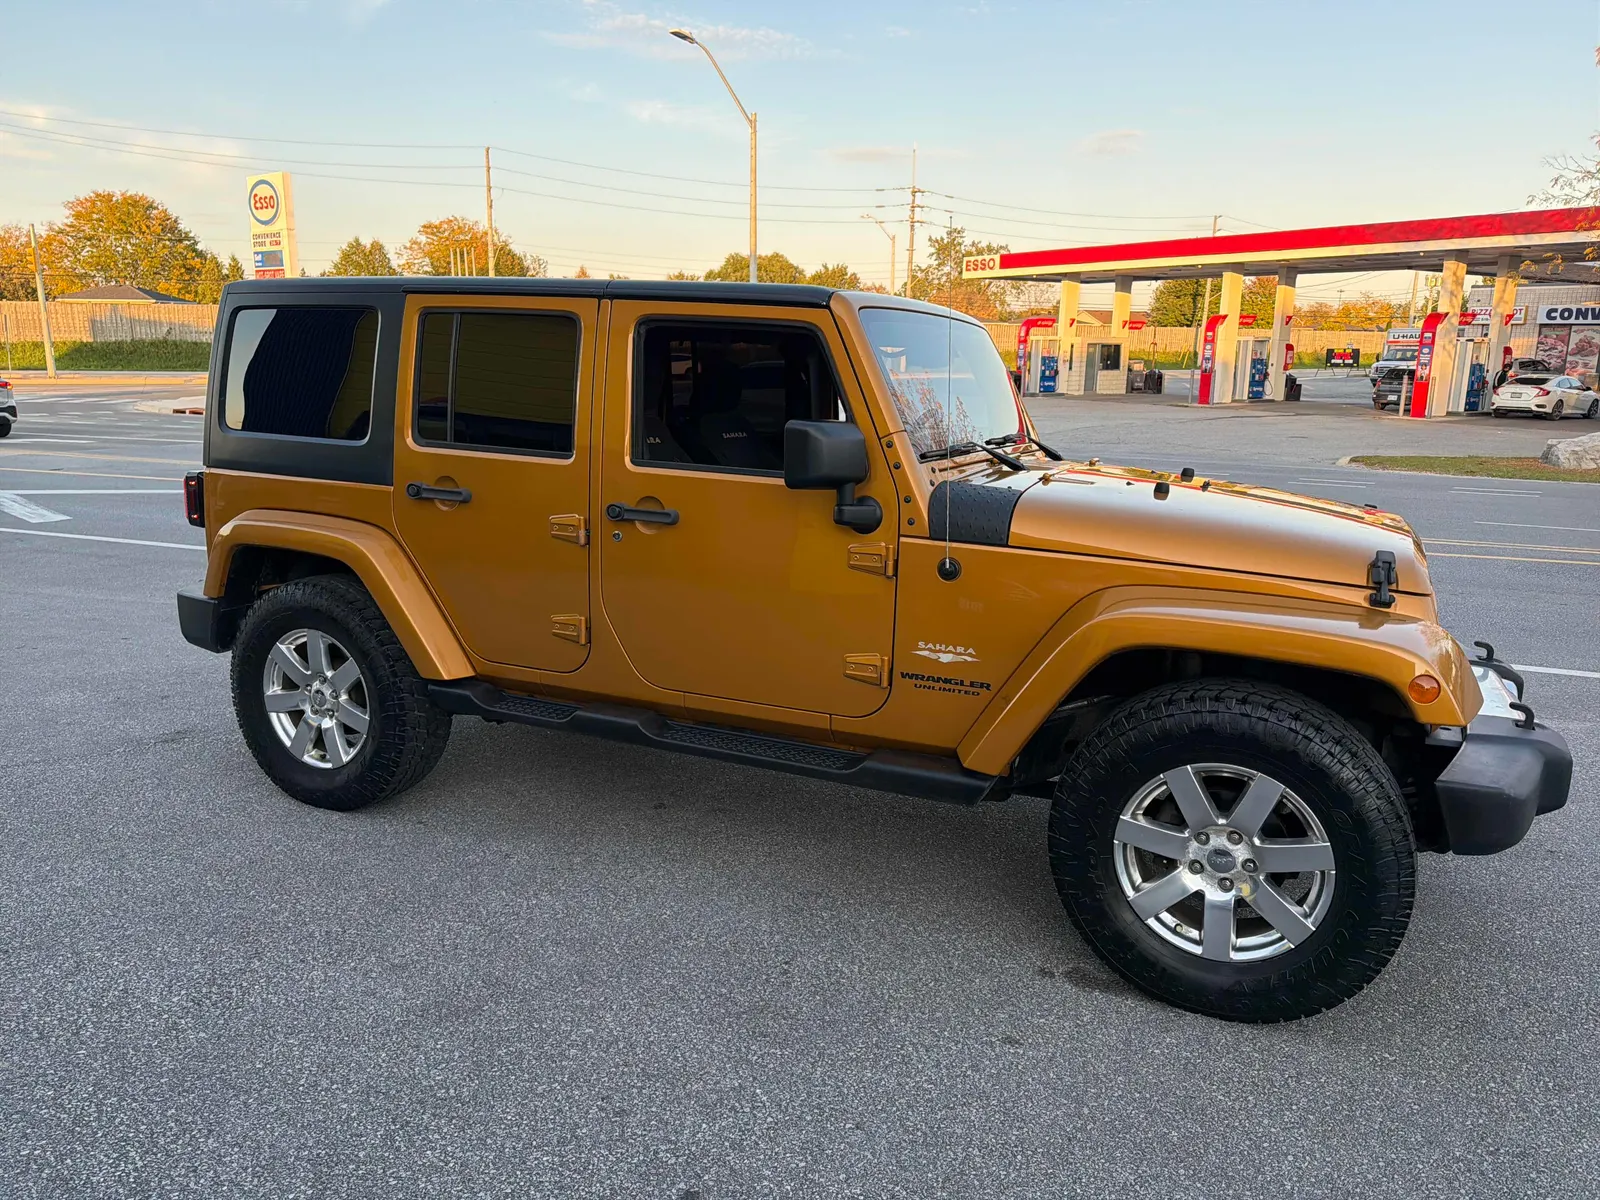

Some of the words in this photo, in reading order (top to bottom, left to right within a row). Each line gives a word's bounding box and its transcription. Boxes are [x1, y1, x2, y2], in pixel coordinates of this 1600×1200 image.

[965, 258, 996, 271] ESSO
[918, 641, 976, 655] SAHARA
[900, 671, 992, 692] WRANGLER
[913, 683, 981, 697] UNLIMITED
